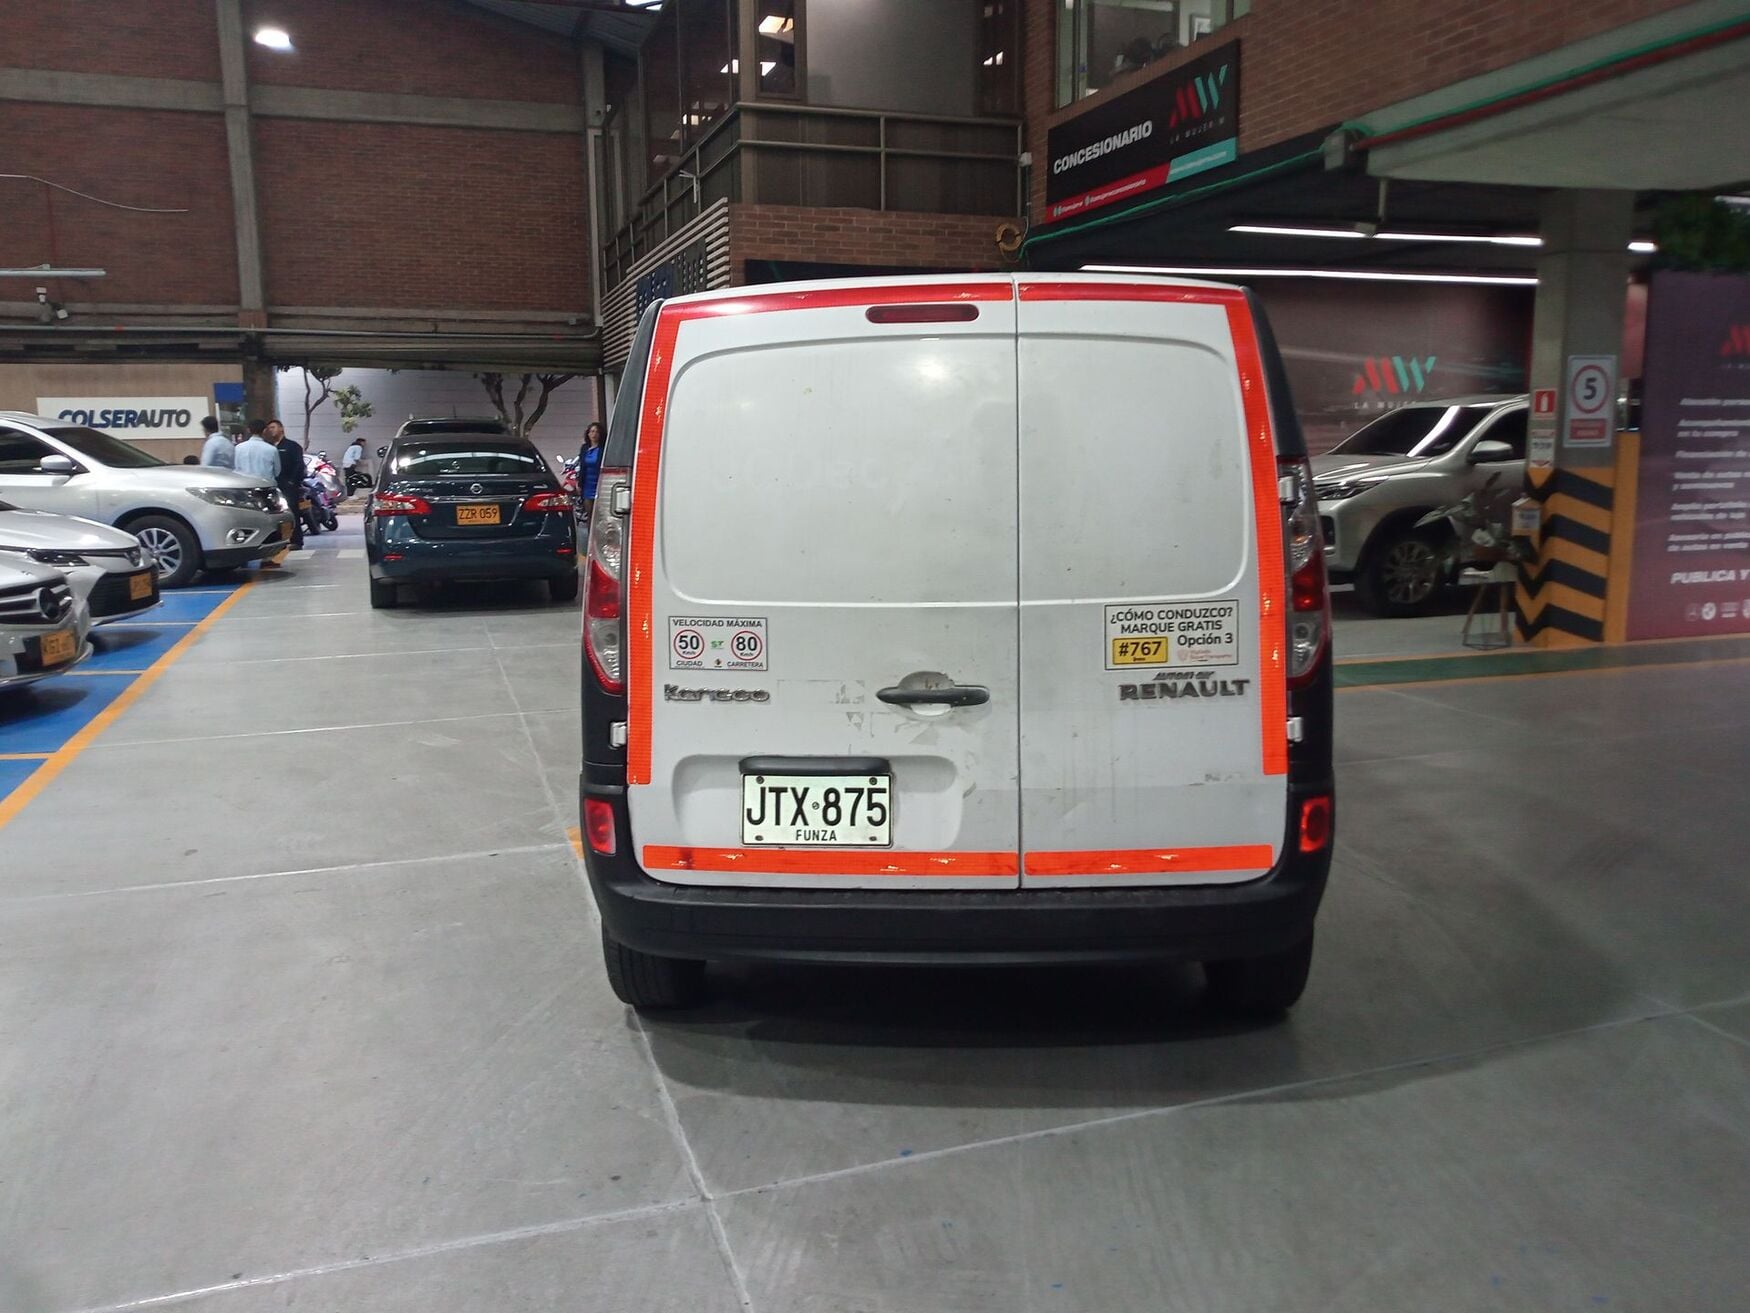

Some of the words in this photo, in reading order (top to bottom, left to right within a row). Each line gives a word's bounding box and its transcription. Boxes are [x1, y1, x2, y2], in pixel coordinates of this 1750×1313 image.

[1053, 120, 1153, 175] CONCESIONARIO
[1583, 377, 1598, 401] 5
[58, 409, 192, 428] COLSERAUTO
[458, 507, 477, 521] ZZR
[479, 507, 498, 519] 059
[1670, 569, 1736, 585] PUBLICA
[672, 618, 724, 628] VELOCIDAD
[726, 619, 762, 628] MÁXIMA
[1110, 608, 1154, 624] ¿CÓMO
[1157, 607, 1234, 621] CONDUZCO?
[1120, 622, 1175, 635] MARQUE
[1178, 620, 1223, 632] GRATIS
[678, 635, 700, 650] 50
[735, 636, 758, 652] 80
[1177, 632, 1221, 648] Opción
[1225, 632, 1234, 645] 3
[1118, 641, 1162, 657] #767
[1118, 680, 1250, 701] RENAULT
[746, 786, 810, 827] JTX
[821, 787, 888, 827] 875
[795, 829, 837, 842] FUNZA
